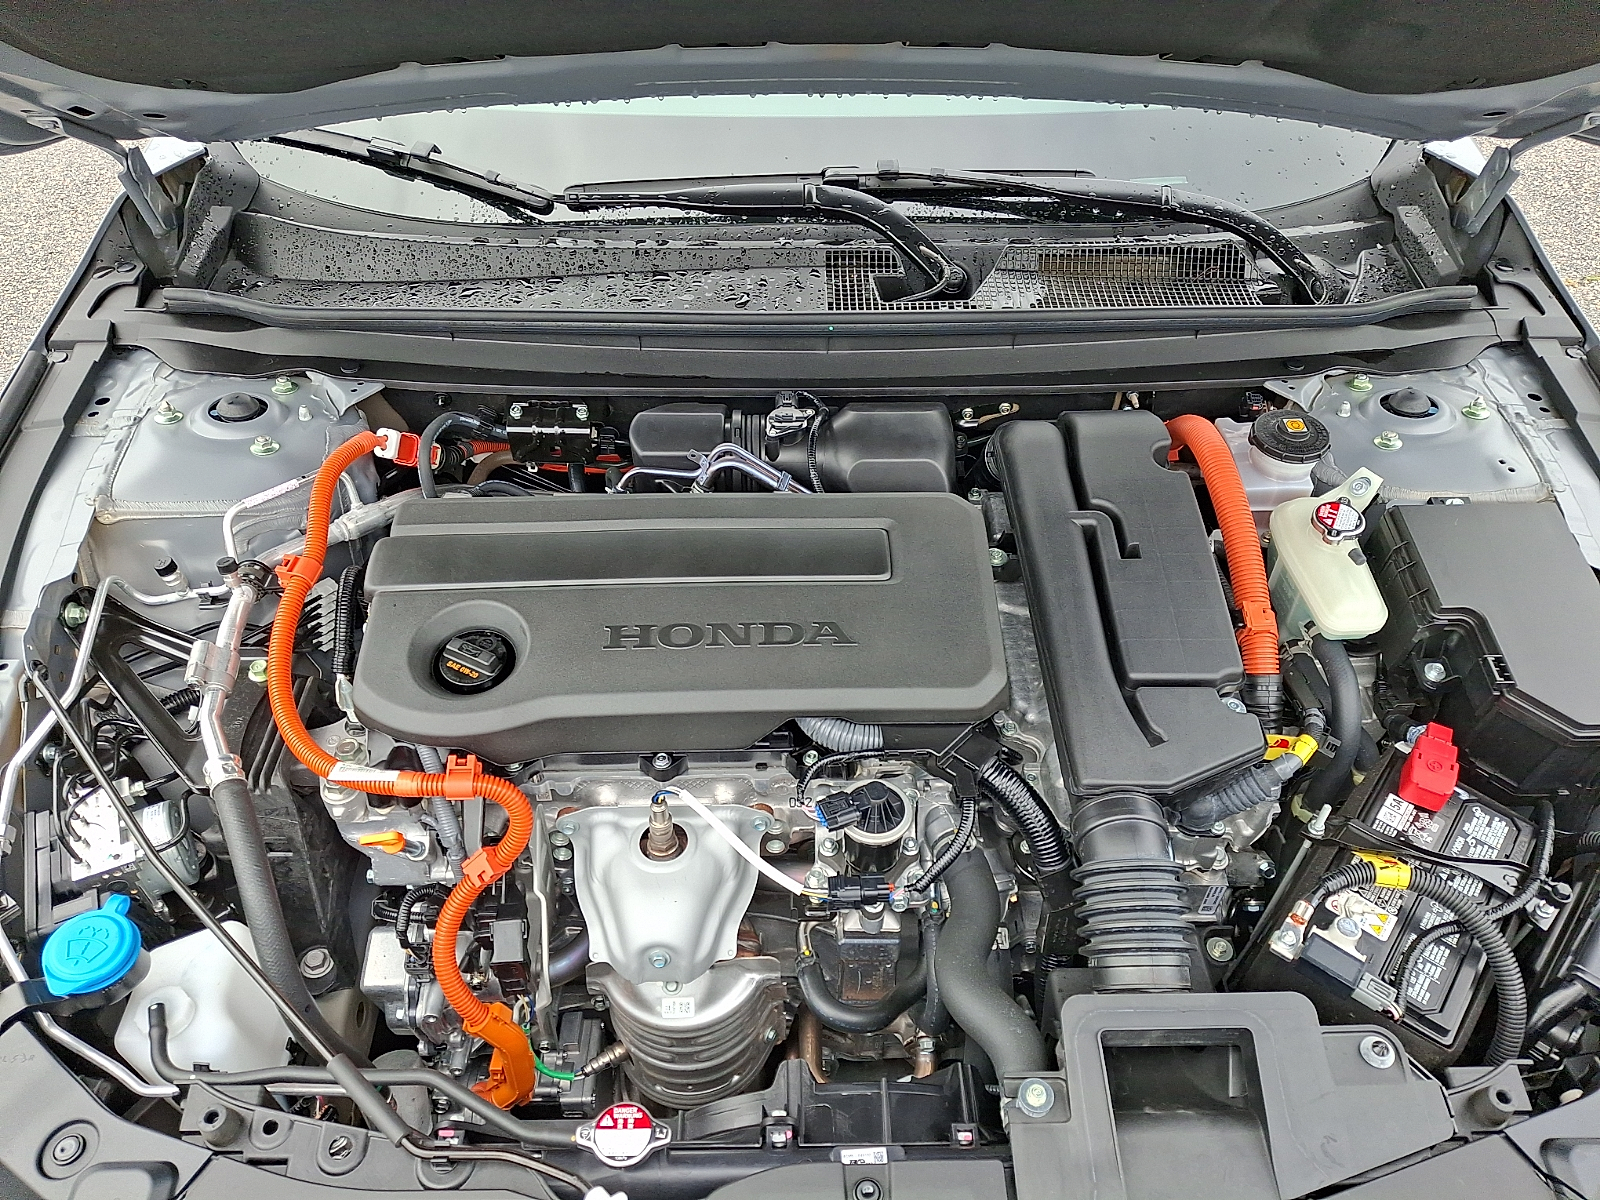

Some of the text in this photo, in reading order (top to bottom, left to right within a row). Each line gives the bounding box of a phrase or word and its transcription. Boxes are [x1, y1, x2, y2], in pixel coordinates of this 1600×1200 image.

[602, 621, 858, 650] HONDA
[446, 660, 479, 679] SAE 0W-20
[1389, 798, 1403, 810] 5A
